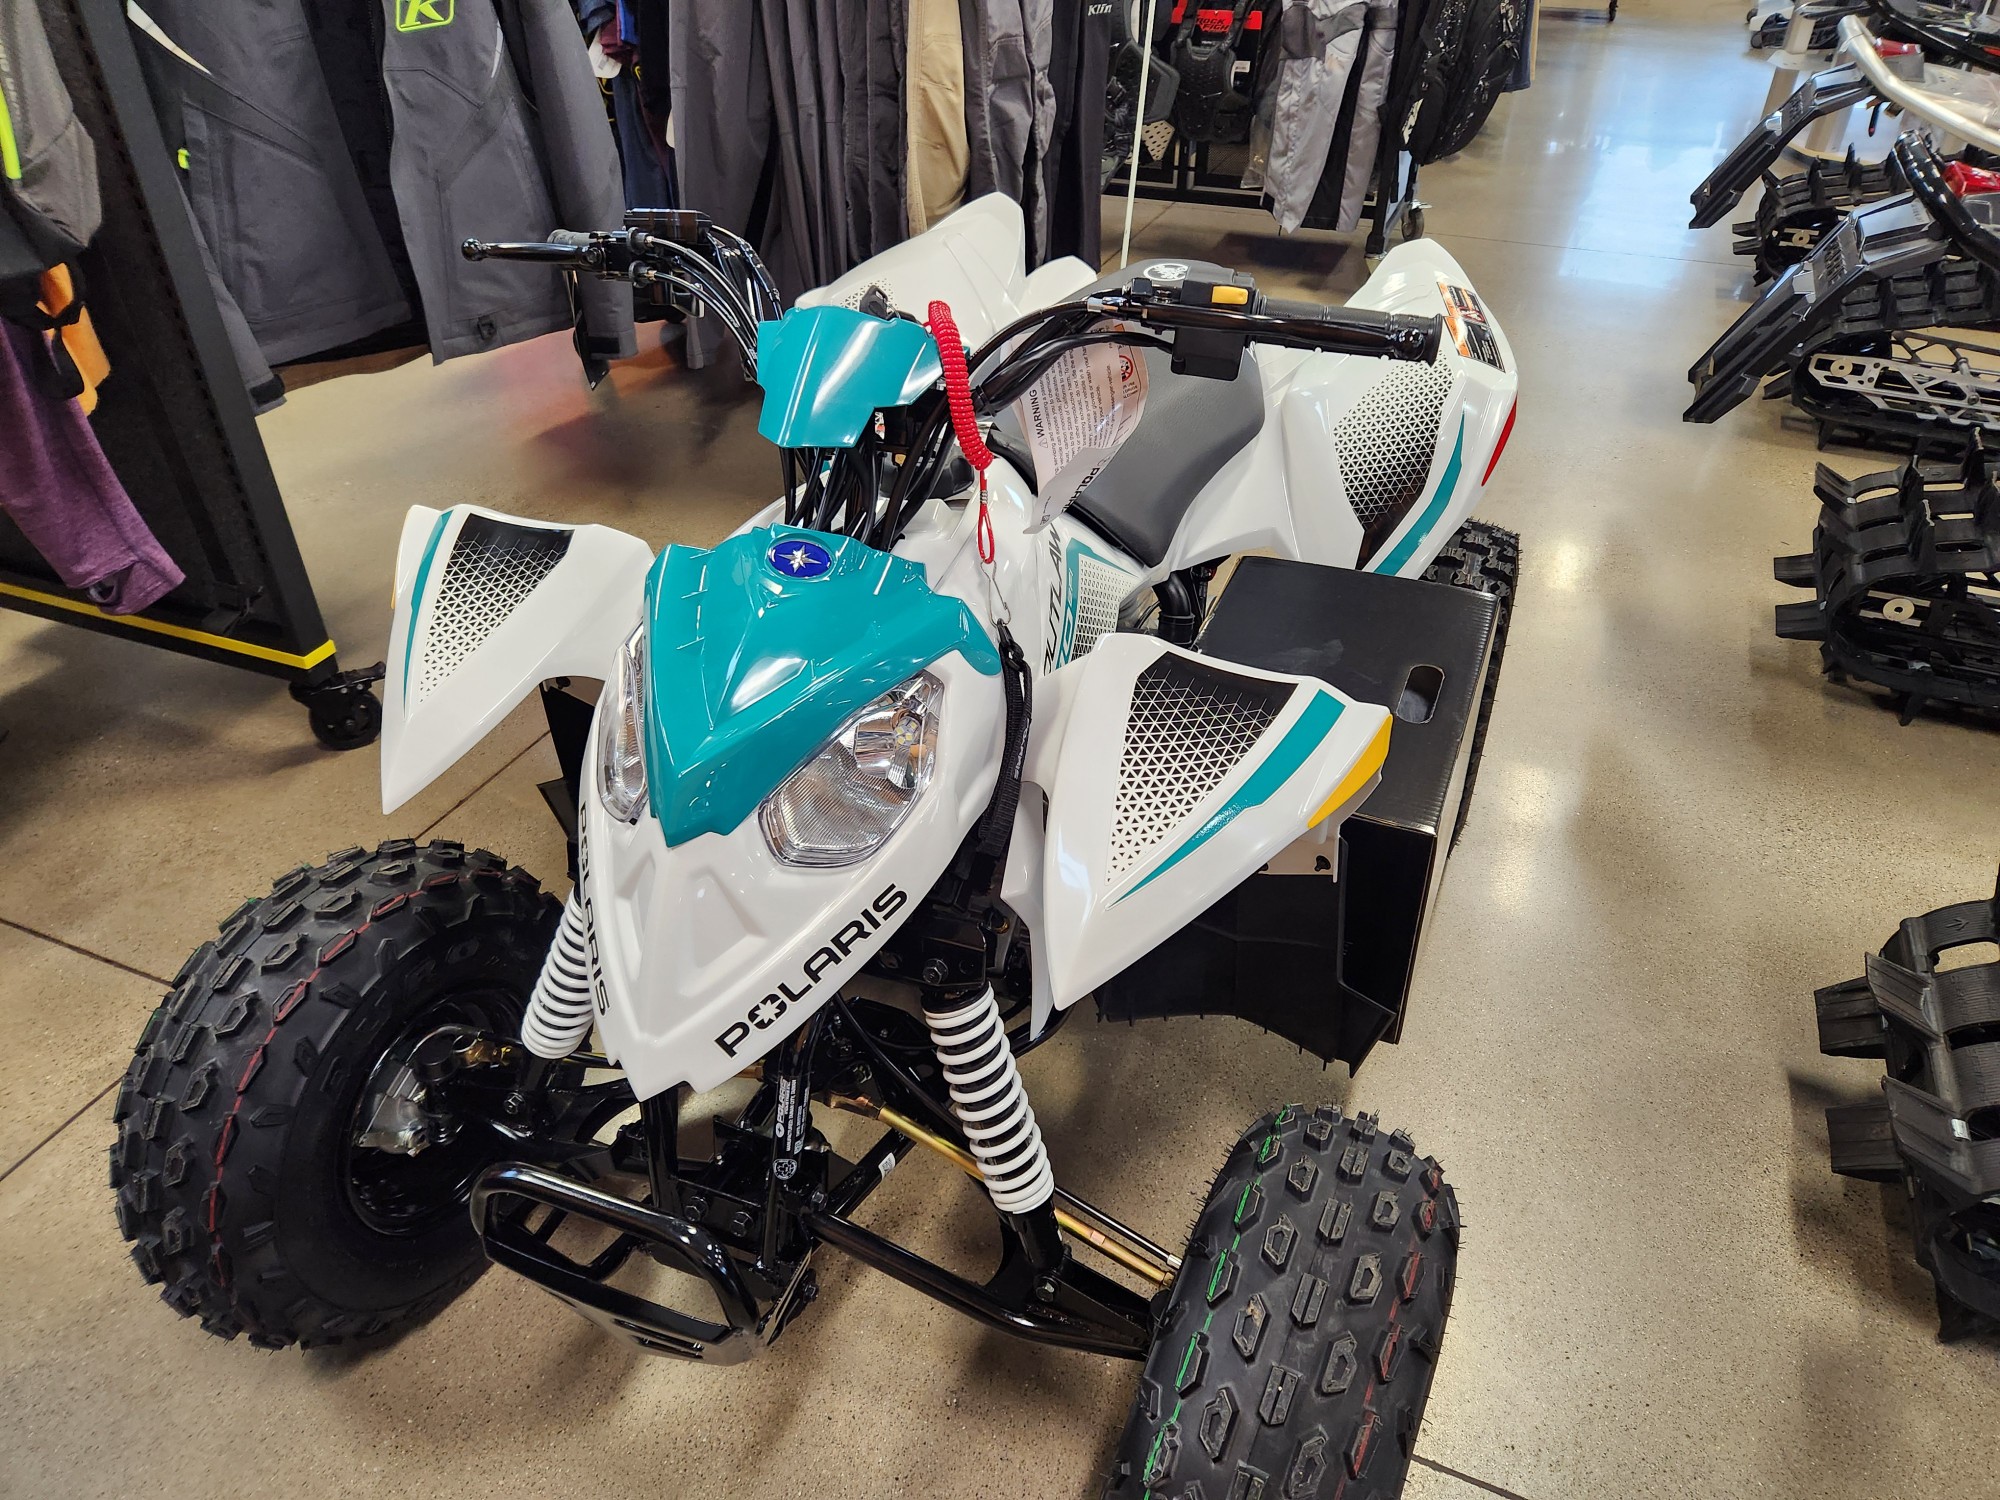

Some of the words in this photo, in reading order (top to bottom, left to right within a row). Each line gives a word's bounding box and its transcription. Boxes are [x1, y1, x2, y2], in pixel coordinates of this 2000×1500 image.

[1202, 23, 1230, 31] FIGH
[1029, 389, 1045, 439] WARNING
[580, 801, 611, 1017] POLARIS
[714, 883, 908, 1058] POLARIS
